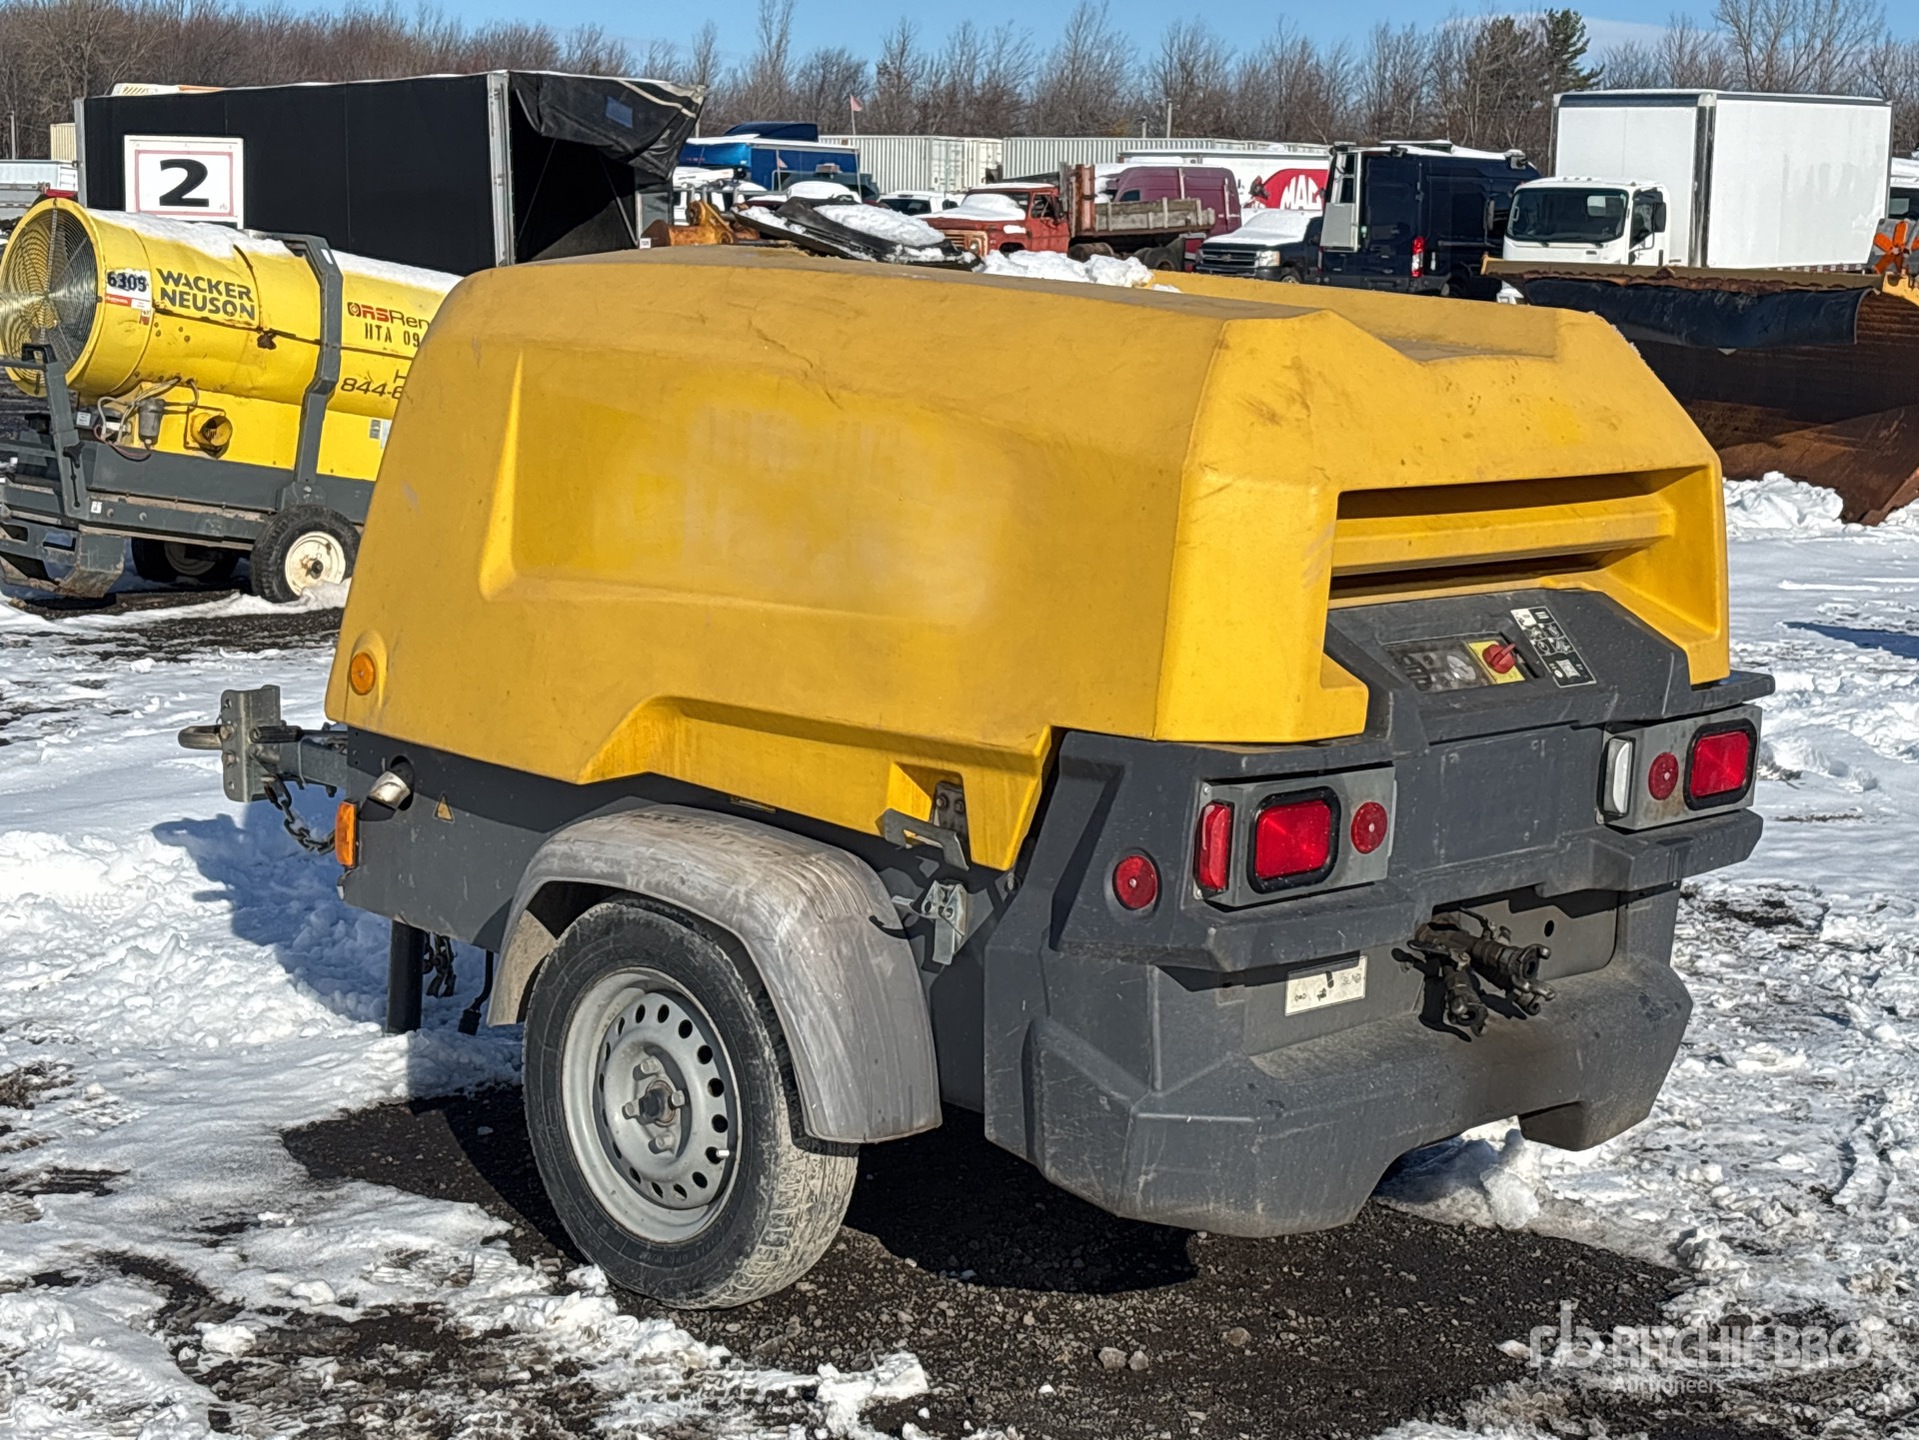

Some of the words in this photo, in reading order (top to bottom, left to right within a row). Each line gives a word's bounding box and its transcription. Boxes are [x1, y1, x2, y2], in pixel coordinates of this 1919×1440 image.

[158, 158, 210, 207] 2
[1280, 175, 1323, 210] MAC
[156, 268, 255, 302] WACKER
[160, 286, 256, 321] NEUSON
